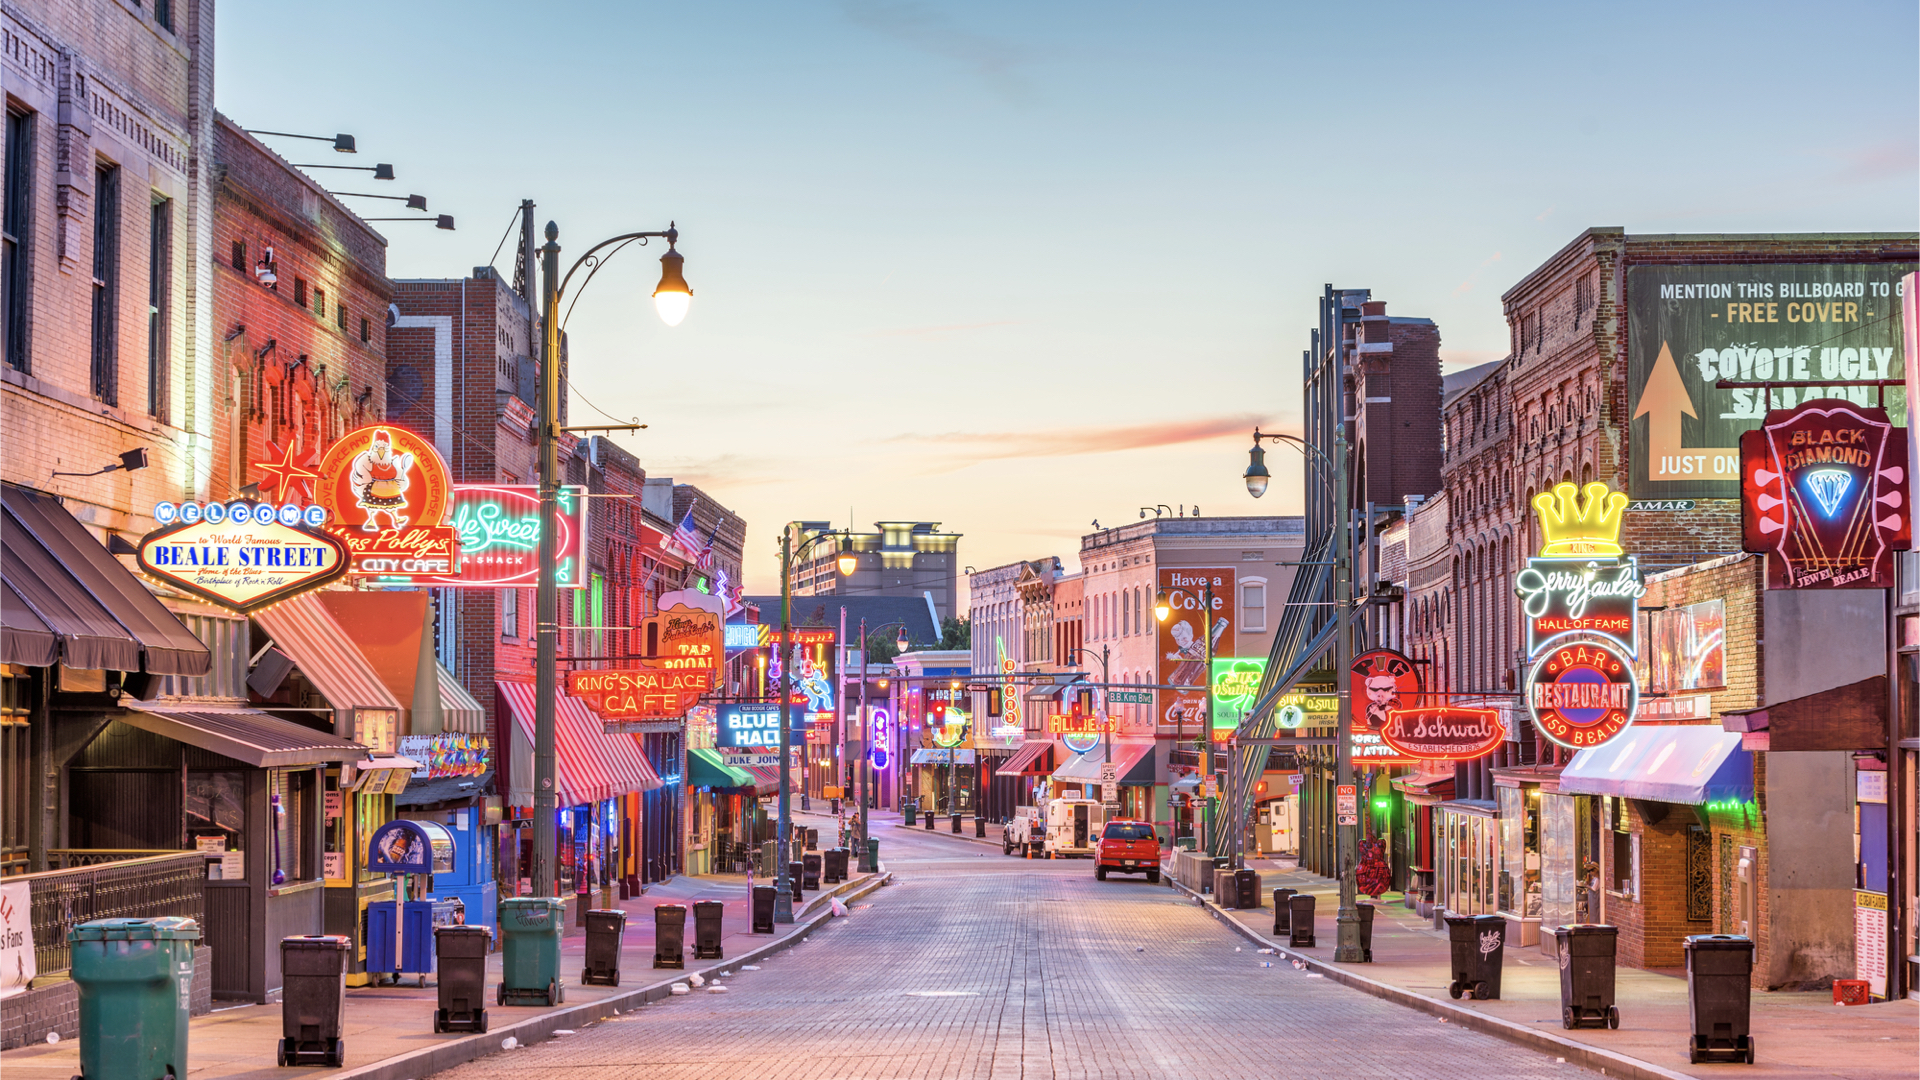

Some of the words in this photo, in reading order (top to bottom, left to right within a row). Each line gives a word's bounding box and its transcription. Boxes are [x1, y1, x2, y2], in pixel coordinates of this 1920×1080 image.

[1661, 284, 1732, 299] MENTION
[1739, 283, 1774, 298] THIS
[1780, 282, 1865, 298] BILLBOARD
[1870, 282, 1890, 297] TO
[1727, 303, 1779, 323] FREE
[1787, 302, 1859, 322] COVER
[1697, 347, 1810, 382] COYOTE
[1821, 347, 1893, 380] UGLY
[350, 435, 370, 451] AND
[1791, 429, 1865, 446] BLACK
[327, 447, 347, 480] PEACE
[1659, 456, 1707, 475] JUST
[1787, 447, 1871, 470] DIAMOND
[399, 437, 434, 473] CHICKEN
[427, 474, 441, 518] GREASE
[323, 483, 335, 512] OVE,
[1628, 502, 1688, 510] AMAR
[155, 503, 325, 526] WELCOME
[199, 537, 208, 545] to
[211, 535, 242, 545] World
[245, 535, 282, 546] Famous
[1571, 544, 1595, 553] KING
[155, 546, 230, 566] BEALE
[239, 547, 327, 567] STREET
[477, 557, 523, 565] SHACK
[198, 567, 221, 576] Home
[222, 568, 229, 577] of
[362, 559, 400, 572] CITY
[403, 559, 449, 572] CAFE
[194, 577, 233, 587] Birthplace
[235, 578, 241, 588] of
[1171, 573, 1207, 586] Have
[1213, 577, 1222, 586] a
[1797, 569, 1832, 588] JEWEL
[1832, 567, 1870, 587] BEALE
[1517, 569, 1585, 618] Jerry
[1570, 561, 1648, 619] Lawler
[1539, 620, 1571, 630] HALL
[1574, 620, 1590, 629] OF
[1595, 620, 1629, 629] FAME
[679, 645, 711, 656] TAP
[1561, 648, 1606, 669] BAR
[1352, 656, 1410, 677] PIG
[637, 675, 706, 689] PALACE
[1225, 672, 1263, 683] SILKY
[606, 694, 677, 712] CAFE
[1110, 693, 1123, 701] B.B.
[1124, 694, 1137, 703] King
[1138, 694, 1152, 703] Blvd.
[1280, 695, 1305, 706] SILKY
[1534, 683, 1631, 709] RESTAURANT
[1388, 716, 1411, 738] A.
[1414, 715, 1498, 738] Schwab
[1544, 714, 1567, 736] 159
[1574, 714, 1625, 744] BEALE
[1408, 743, 1463, 753] ESTABLISHED
[1465, 744, 1481, 753] 1876
[728, 756, 751, 764] JUKE
[7, 928, 23, 949] Fans
